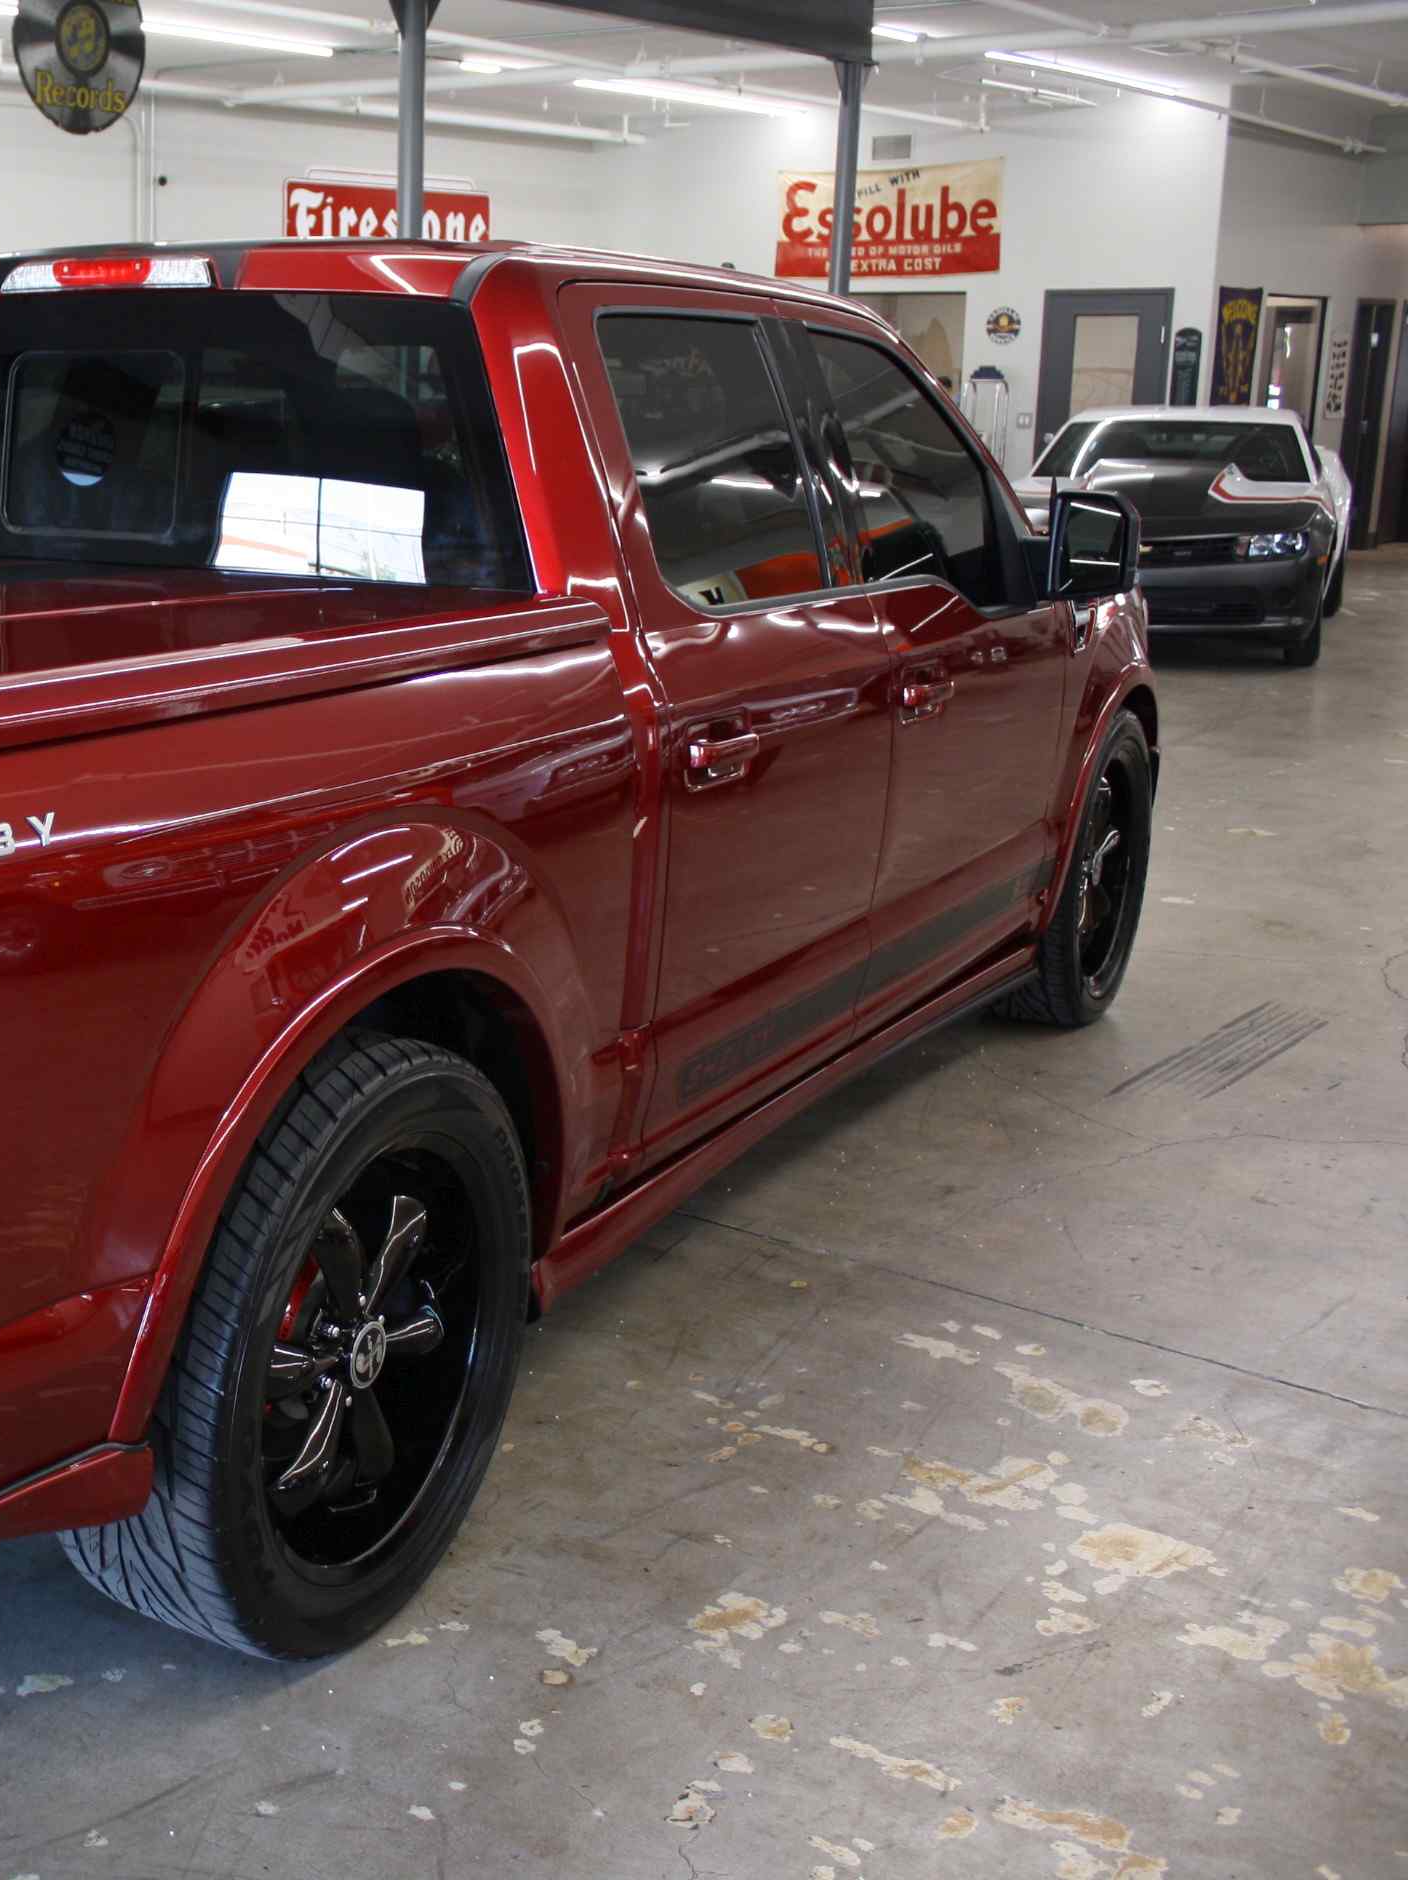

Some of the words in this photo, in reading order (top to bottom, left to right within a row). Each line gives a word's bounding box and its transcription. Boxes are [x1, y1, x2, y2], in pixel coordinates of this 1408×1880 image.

[33, 67, 129, 113] Records
[888, 168, 920, 187] WITH
[290, 188, 487, 243] Firesone
[782, 180, 998, 243] Essolube
[850, 258, 897, 273] EXTRA
[903, 256, 942, 272] COST
[888, 243, 929, 257] MOTOR
[933, 241, 963, 254] OILS
